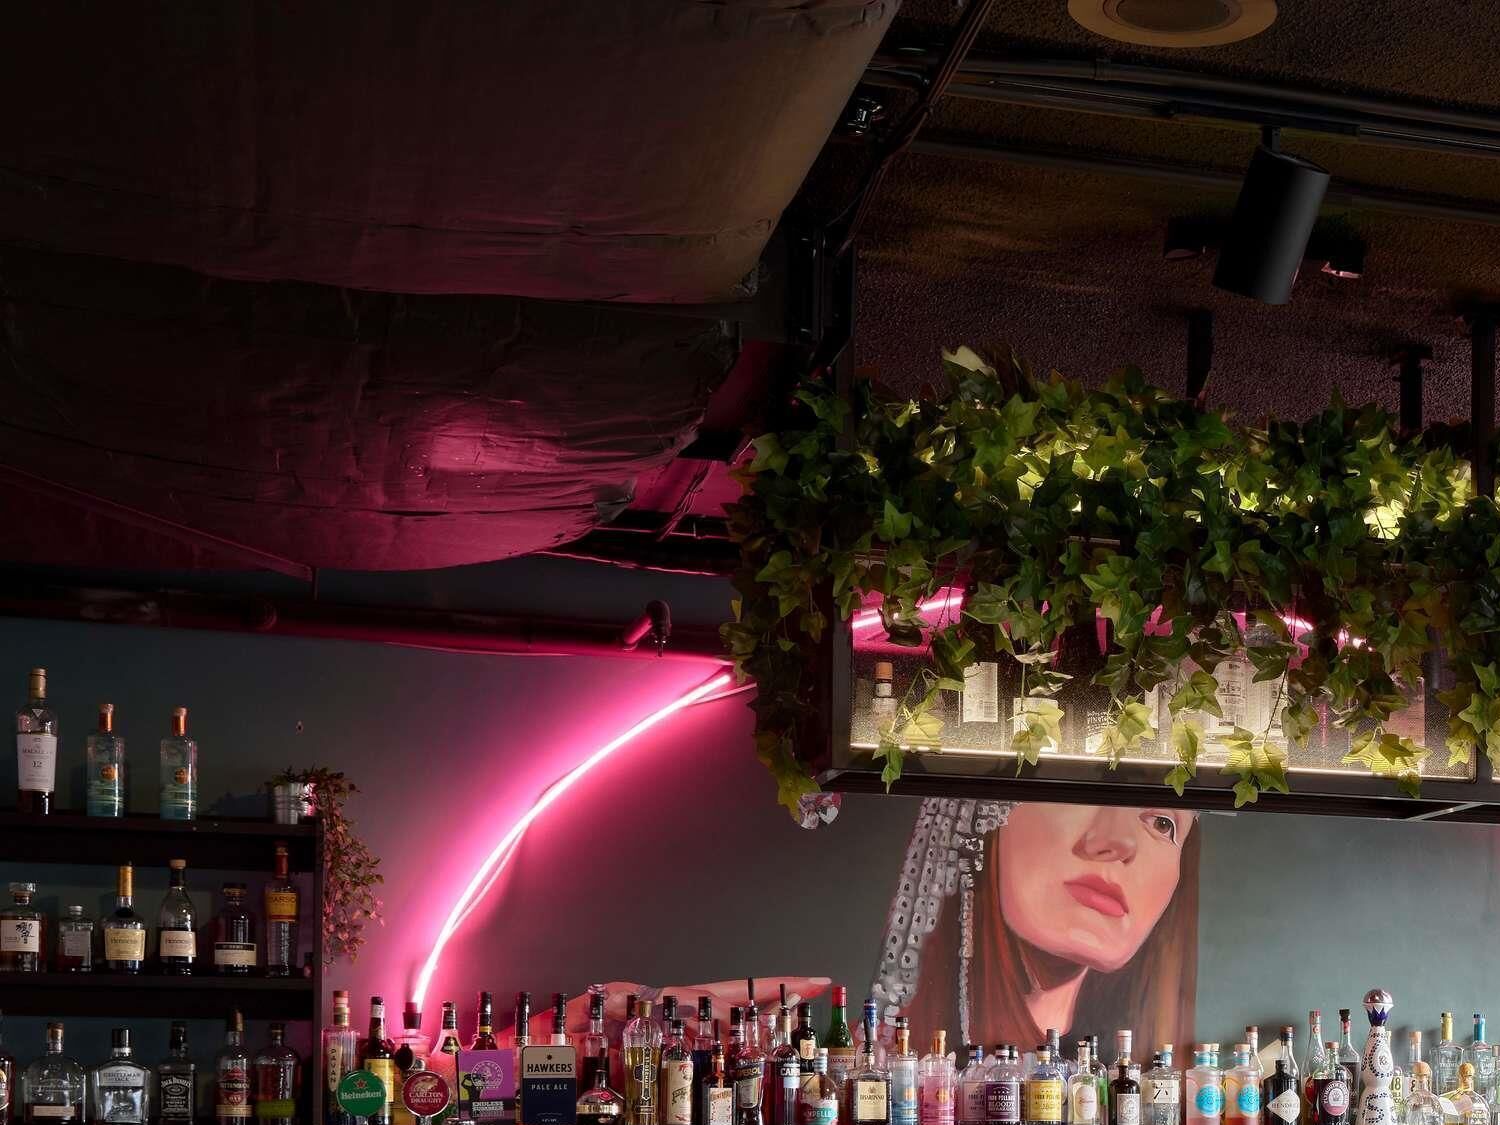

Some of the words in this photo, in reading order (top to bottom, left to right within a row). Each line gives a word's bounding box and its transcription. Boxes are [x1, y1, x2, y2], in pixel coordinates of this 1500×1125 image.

[32, 760, 43, 768] 12
[329, 1048, 337, 1083] PAVAN
[526, 1063, 573, 1073] HAWKERS
[531, 1083, 552, 1091] PALE
[341, 1090, 382, 1100] Heineken
[408, 1091, 443, 1099] CARLTON
